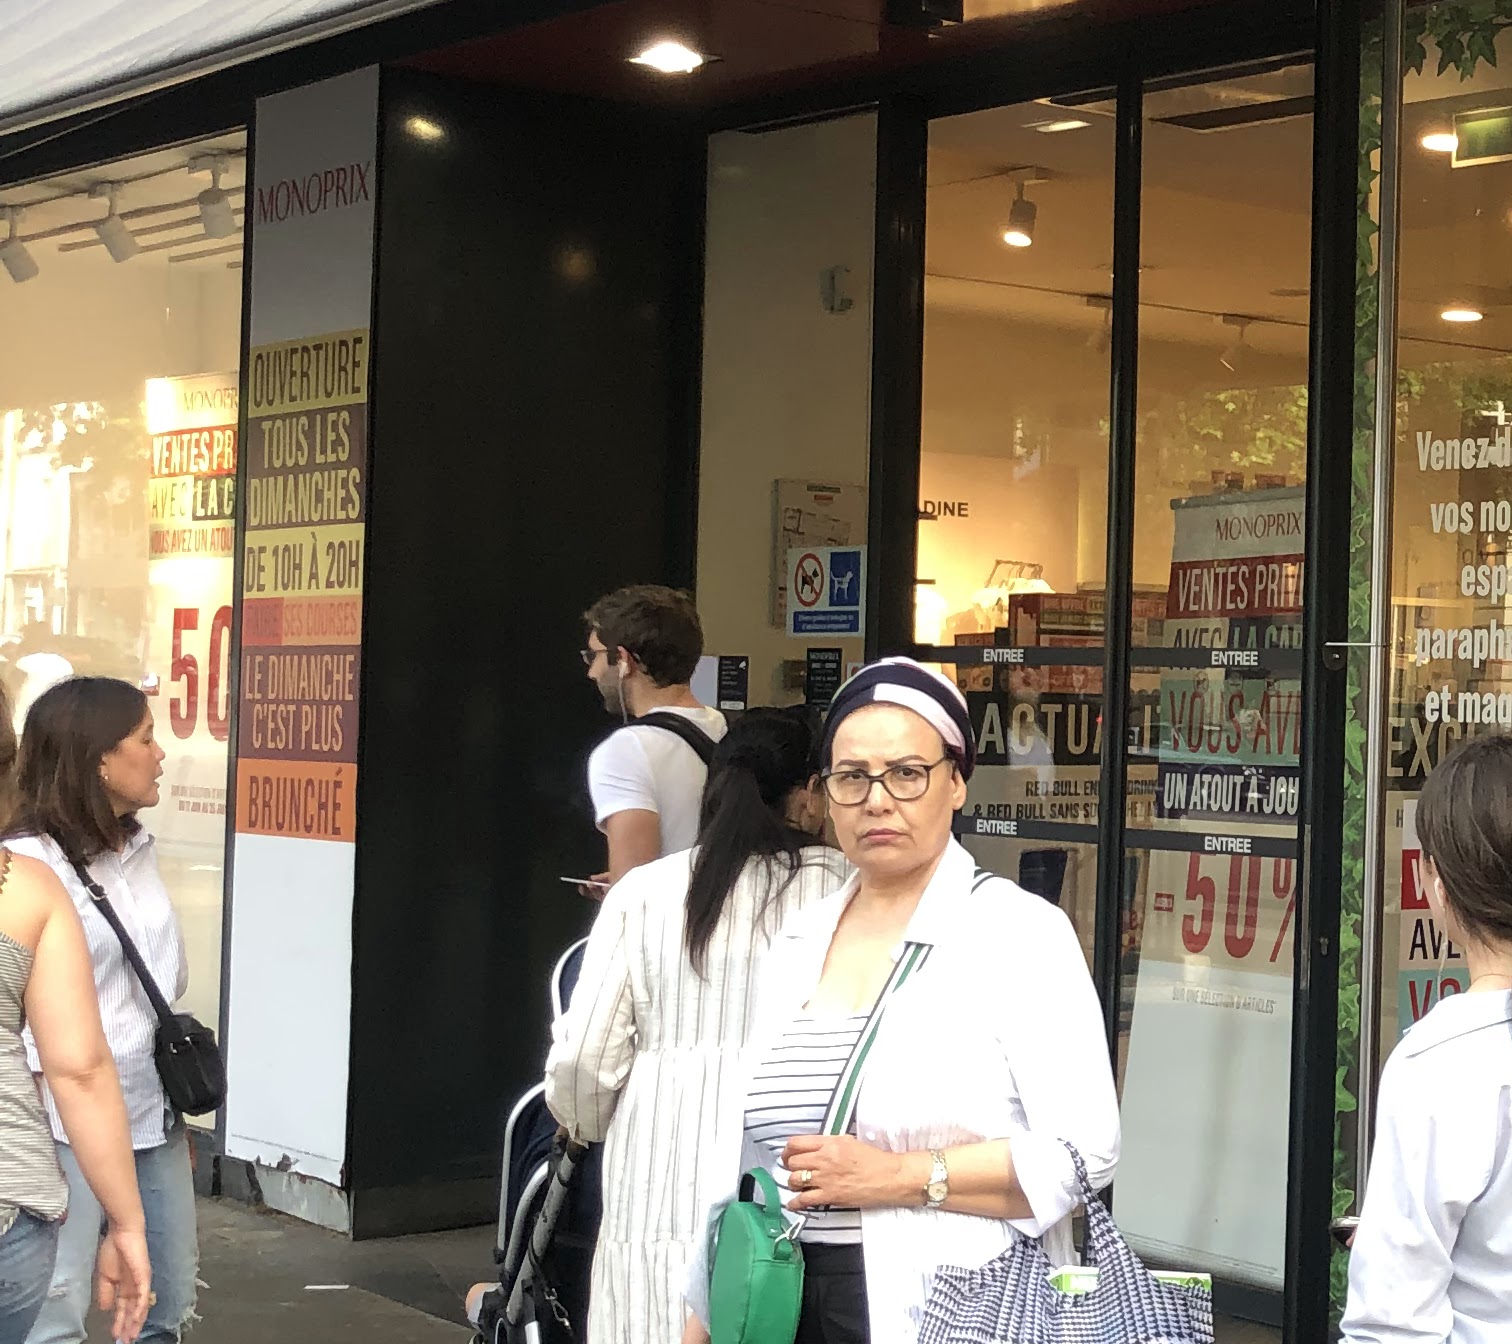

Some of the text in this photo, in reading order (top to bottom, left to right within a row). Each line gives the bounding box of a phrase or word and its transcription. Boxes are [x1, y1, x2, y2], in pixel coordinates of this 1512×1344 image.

[257, 160, 370, 225] MONOPRIX
[253, 336, 363, 408] OUVERTURE
[152, 430, 210, 476] VENTES
[261, 410, 350, 469] TOUS LES
[1416, 430, 1490, 472] Venez
[195, 478, 219, 517] LA
[250, 467, 361, 526] DIMANCHES
[1215, 511, 1302, 541] MONOPRIX
[1430, 501, 1474, 534] vos
[194, 527, 208, 552] UN
[246, 531, 360, 593] DE 10H À 20H
[1178, 565, 1249, 612] VENTES
[284, 603, 303, 637] SES
[306, 601, 358, 637] COURSES
[983, 648, 1024, 663] ENTREE
[1211, 650, 1259, 666] ENTREE
[245, 654, 355, 702] LE DIMANCHE
[1168, 689, 1244, 755] VOUS
[1424, 684, 1452, 724] et
[252, 703, 343, 752] C'EST PLUS
[248, 766, 343, 836] BRUNCHÉ
[1015, 803, 1046, 820] BULL
[1163, 772, 1187, 810] UN
[1189, 773, 1245, 812] ATOUT
[976, 818, 1018, 836] ENTREE
[1204, 835, 1252, 854] ENTREE
